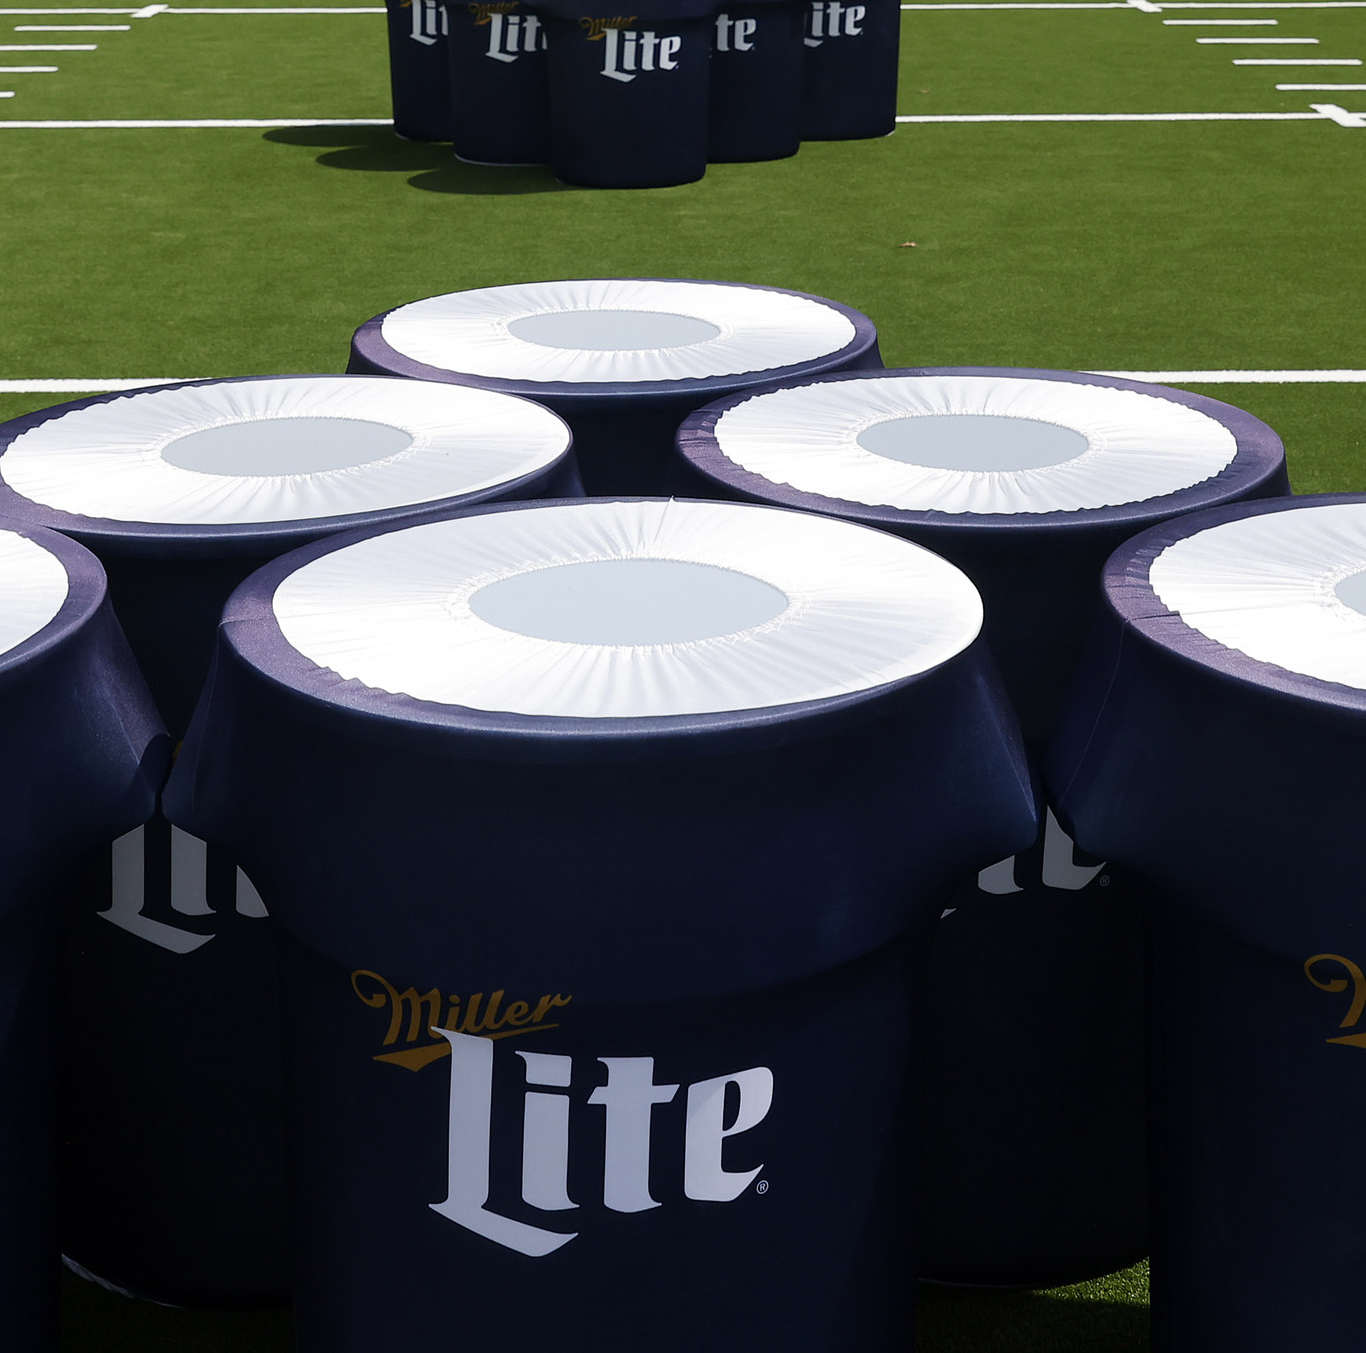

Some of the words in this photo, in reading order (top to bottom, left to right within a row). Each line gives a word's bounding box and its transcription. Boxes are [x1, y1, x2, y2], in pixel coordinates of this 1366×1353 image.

[485, 13, 547, 63] Lit
[579, 16, 637, 40] Miller
[710, 13, 756, 59] te
[600, 28, 681, 83] Lite
[350, 969, 573, 1051] Miller
